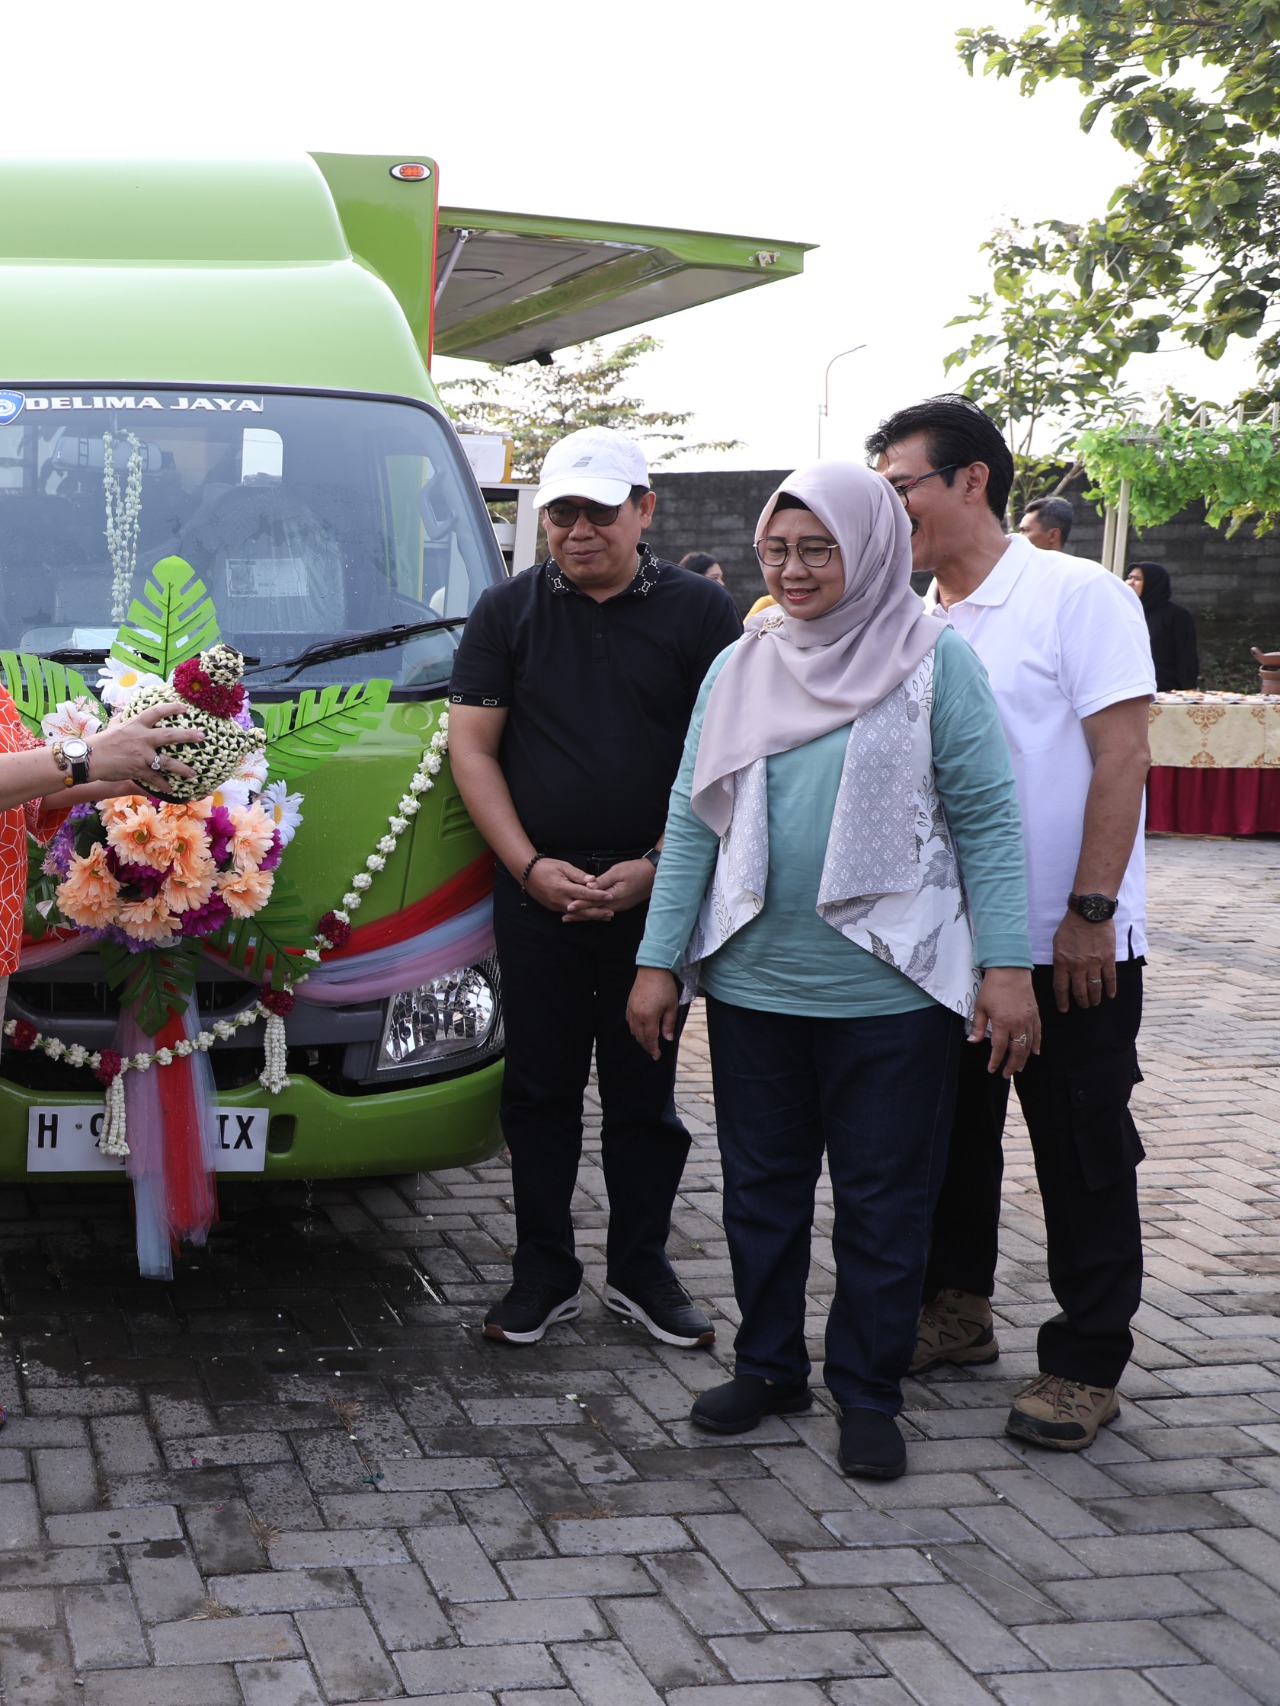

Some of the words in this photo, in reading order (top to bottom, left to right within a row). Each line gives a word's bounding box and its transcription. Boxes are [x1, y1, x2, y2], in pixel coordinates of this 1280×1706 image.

[25, 396, 164, 411] DELIMA
[169, 397, 263, 413] JAYA
[37, 1113, 59, 1149] H
